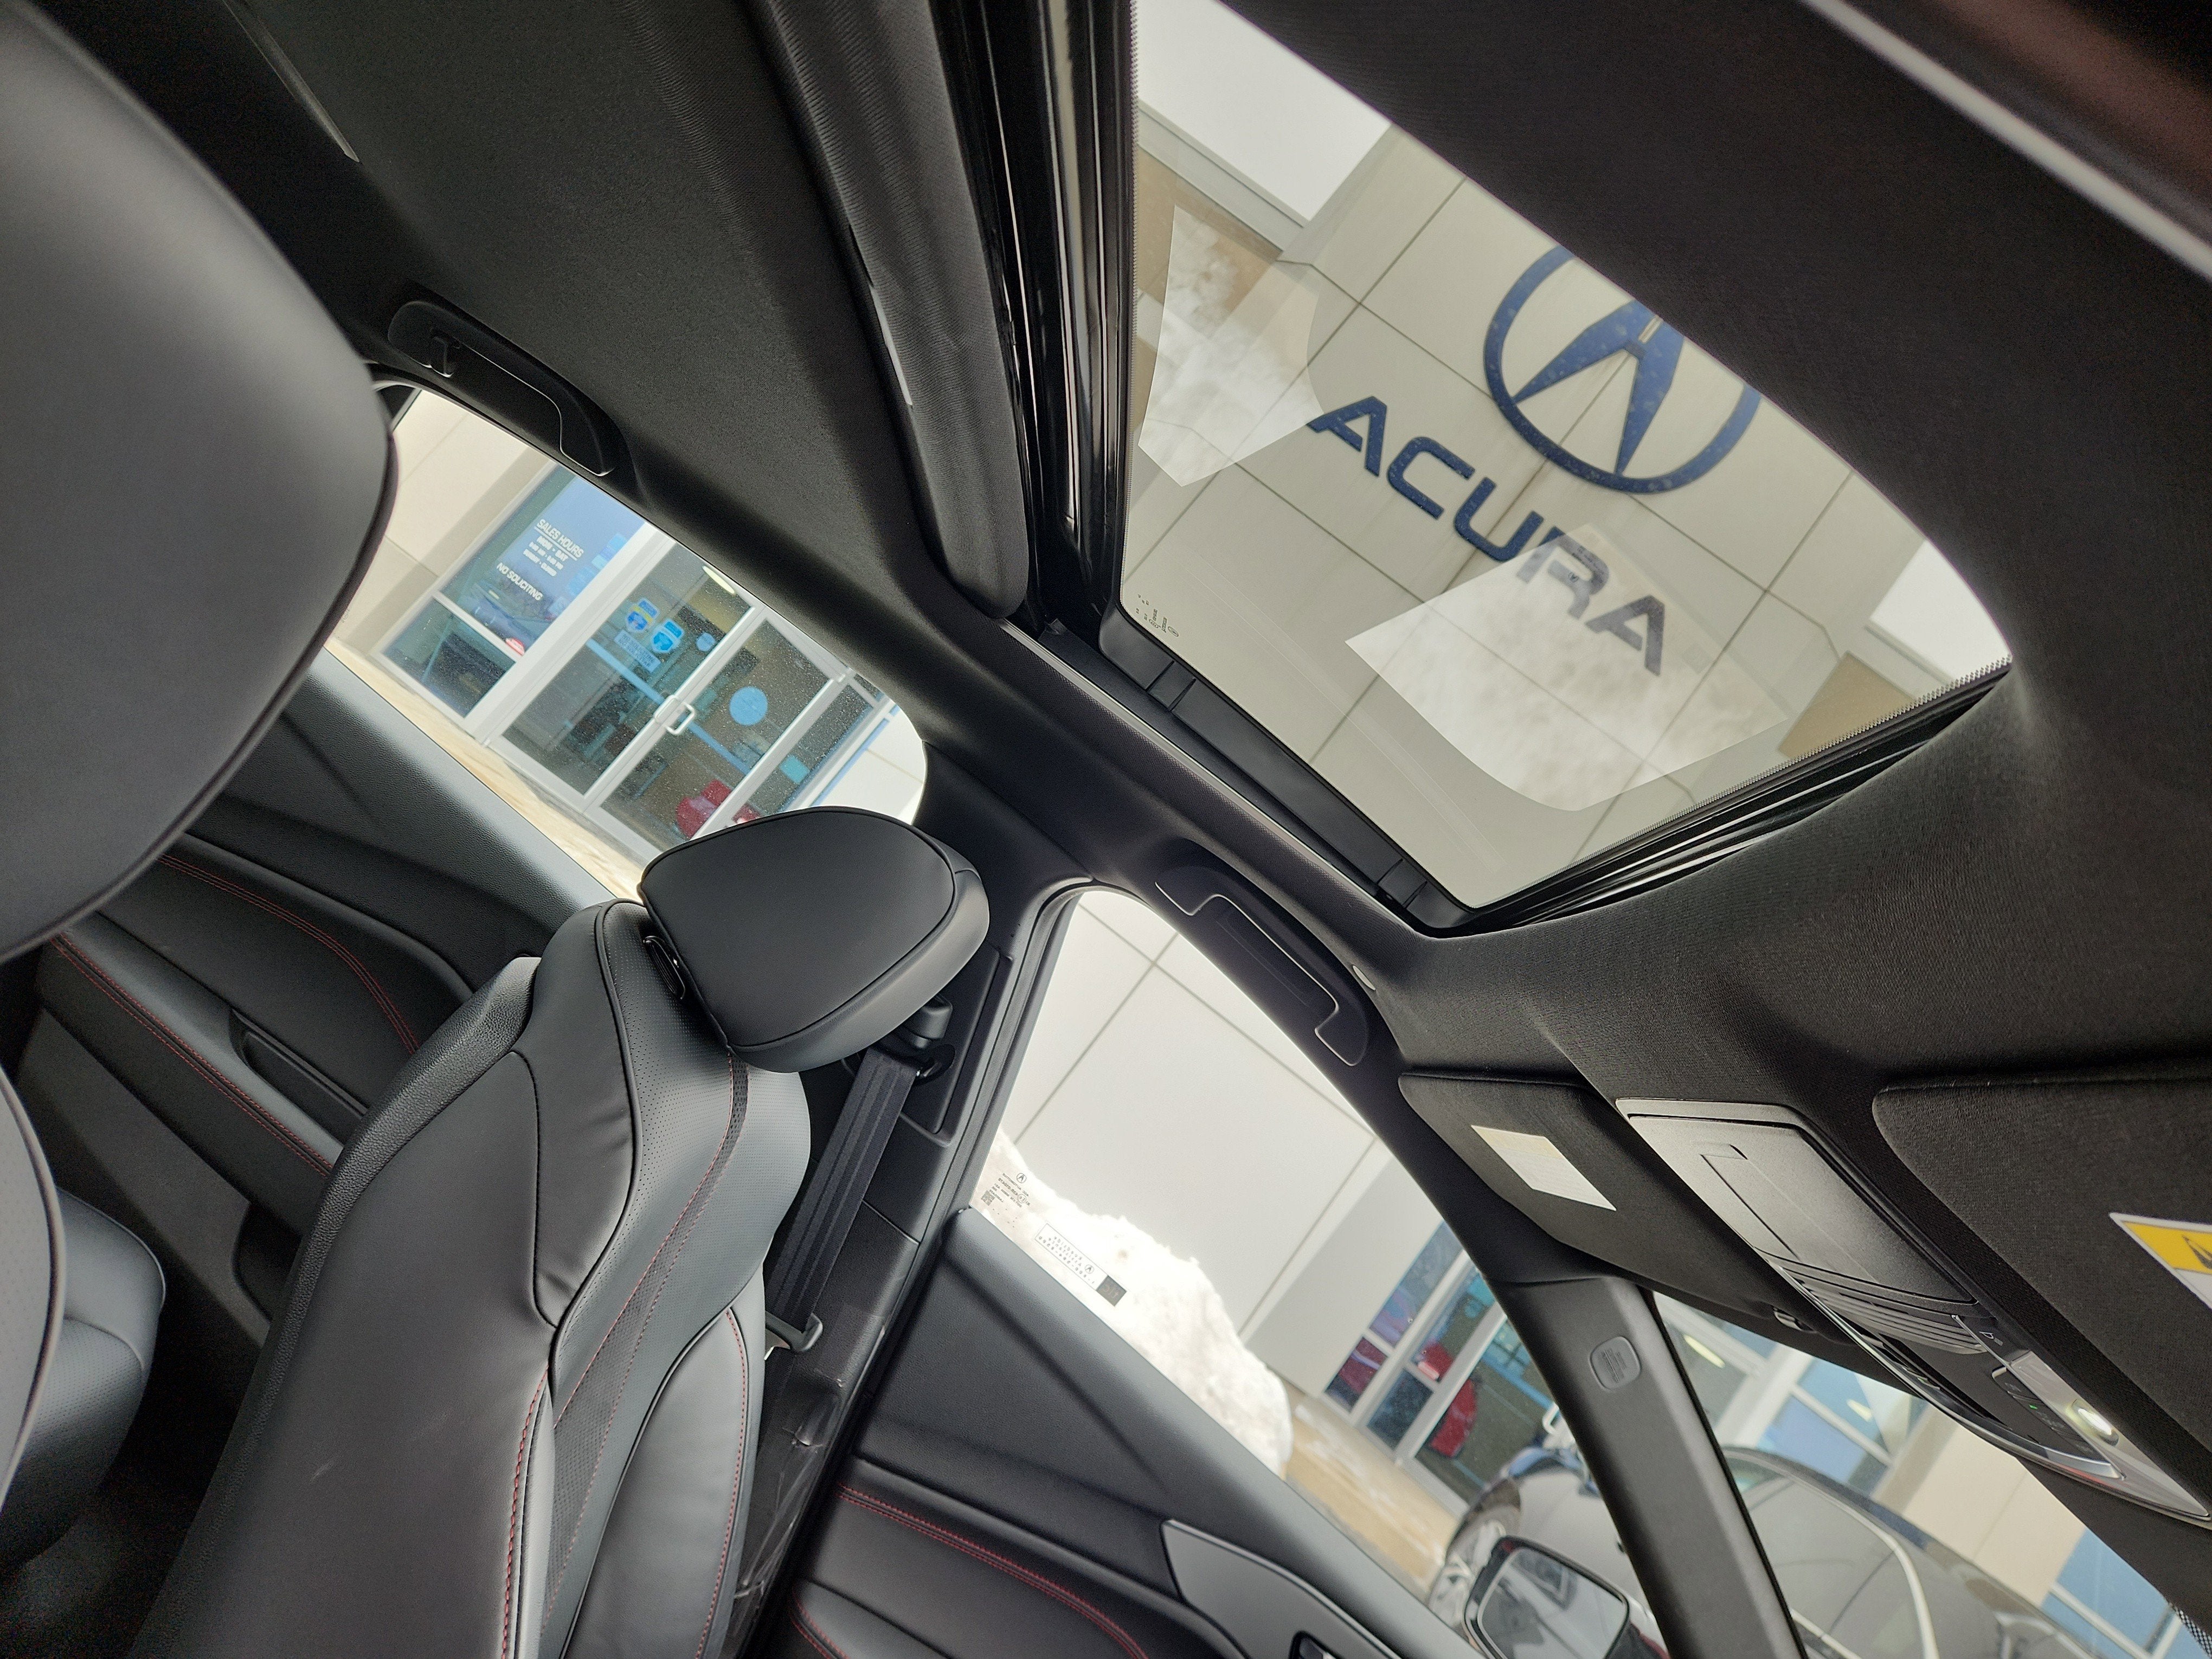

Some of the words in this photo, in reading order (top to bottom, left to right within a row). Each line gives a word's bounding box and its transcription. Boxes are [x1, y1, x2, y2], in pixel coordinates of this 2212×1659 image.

[537, 519, 561, 539] SALES
[557, 535, 584, 557] HOURS
[1306, 395, 1666, 677] ACURA
[496, 562, 510, 575] NO
[506, 570, 543, 601] SOLICITING
